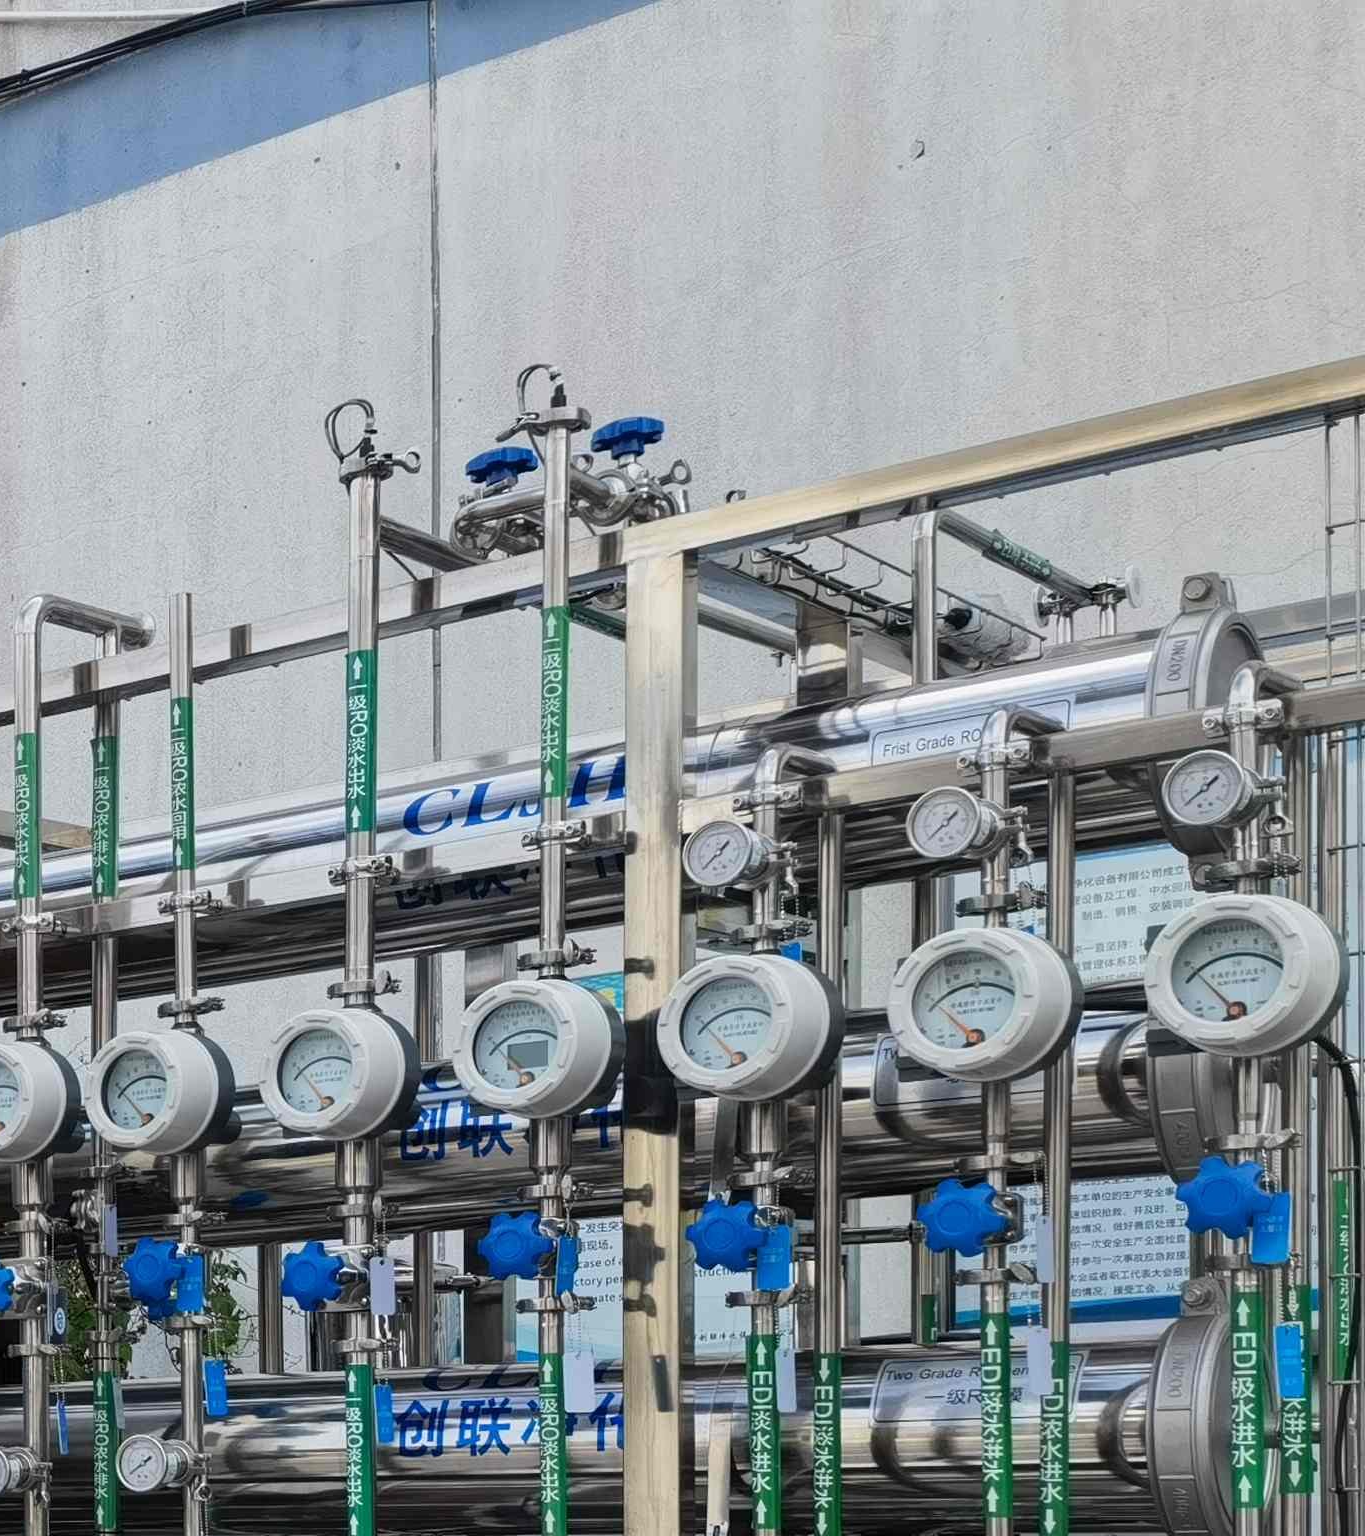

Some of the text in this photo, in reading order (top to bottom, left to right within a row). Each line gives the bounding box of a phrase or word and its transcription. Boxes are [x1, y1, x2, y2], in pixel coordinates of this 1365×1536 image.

[883, 741, 910, 757] Frist
[916, 733, 955, 752] Grade
[540, 1384, 561, 1503] 二级RO淡水出水
[751, 1370, 773, 1493] EDI淡水进水
[1231, 1332, 1257, 1468] EDI极水进水
